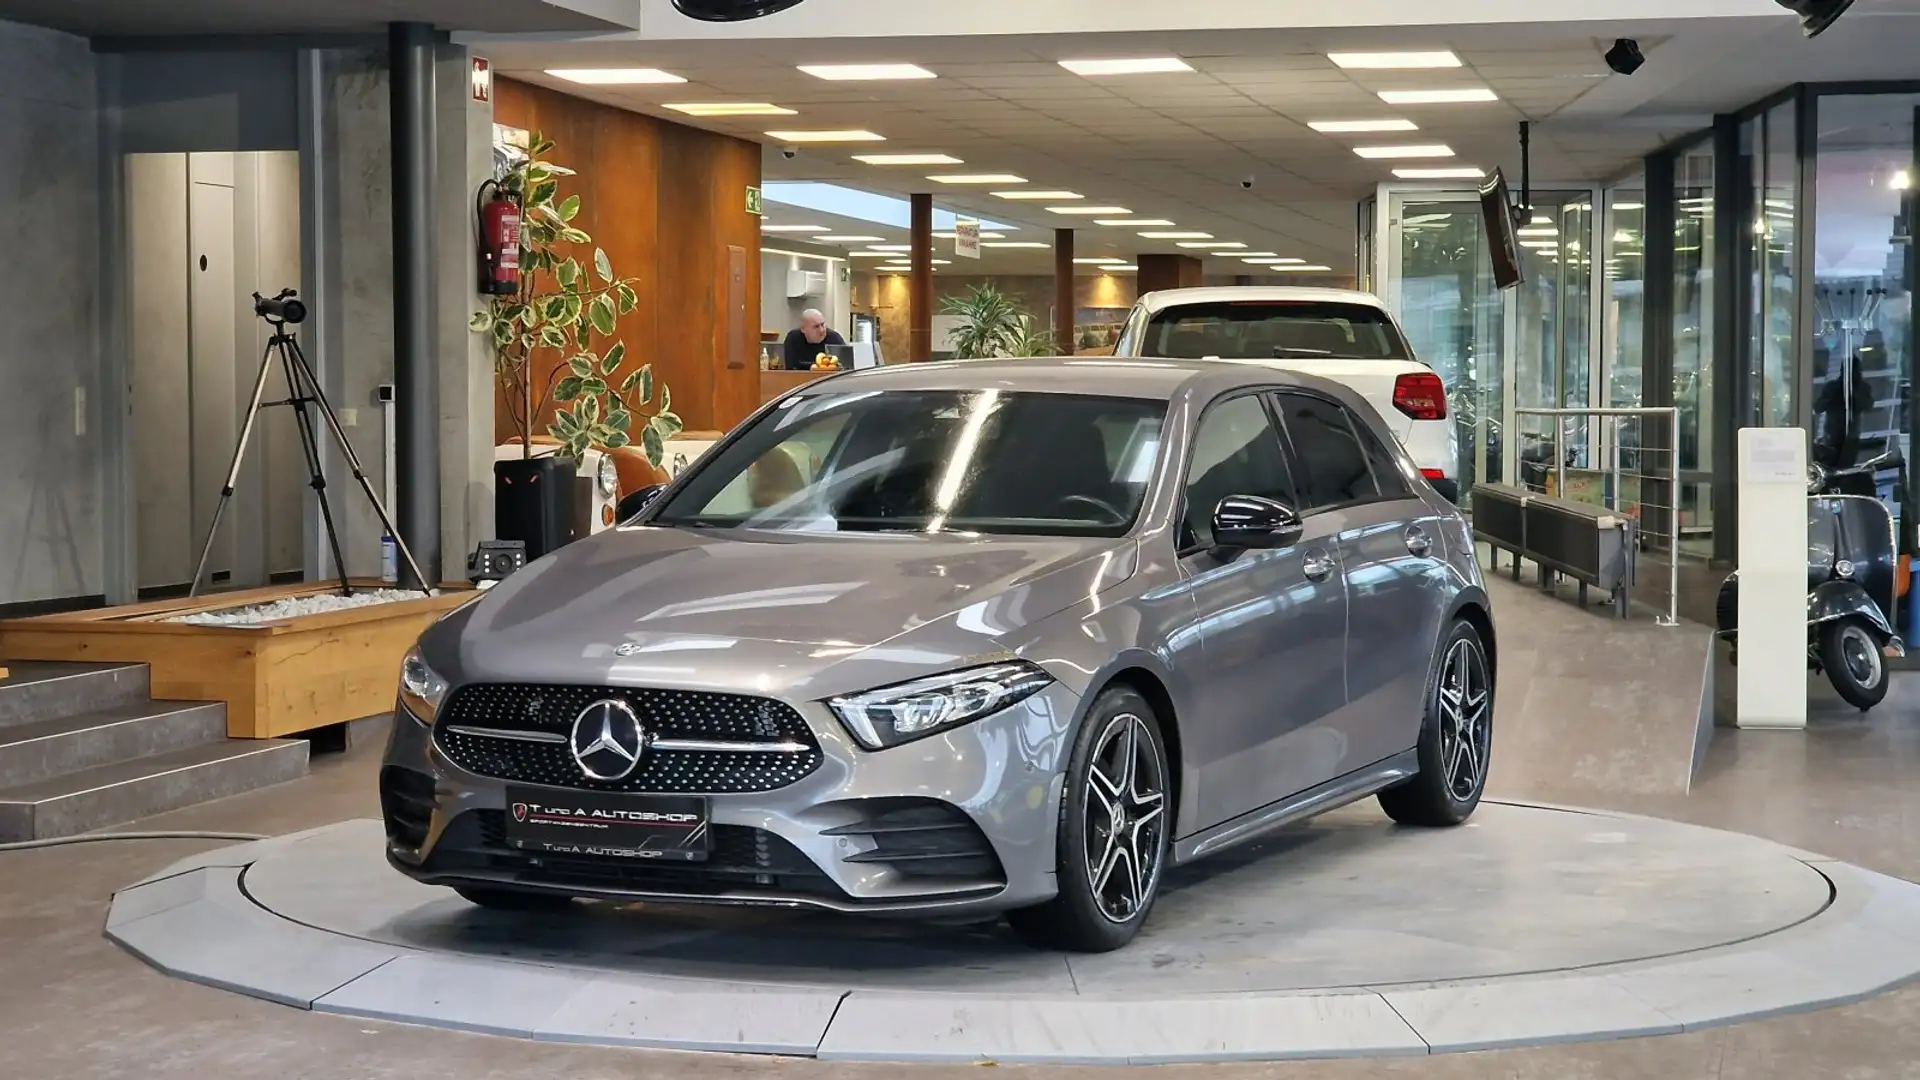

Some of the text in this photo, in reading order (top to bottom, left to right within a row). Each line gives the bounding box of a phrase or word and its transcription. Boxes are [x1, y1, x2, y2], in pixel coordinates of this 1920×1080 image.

[529, 804, 541, 812] T
[574, 807, 587, 816] A
[591, 809, 698, 821] AUTOSHOP
[543, 843, 552, 851] T
[571, 845, 581, 853] A
[585, 847, 663, 857] AUTOSHOP
